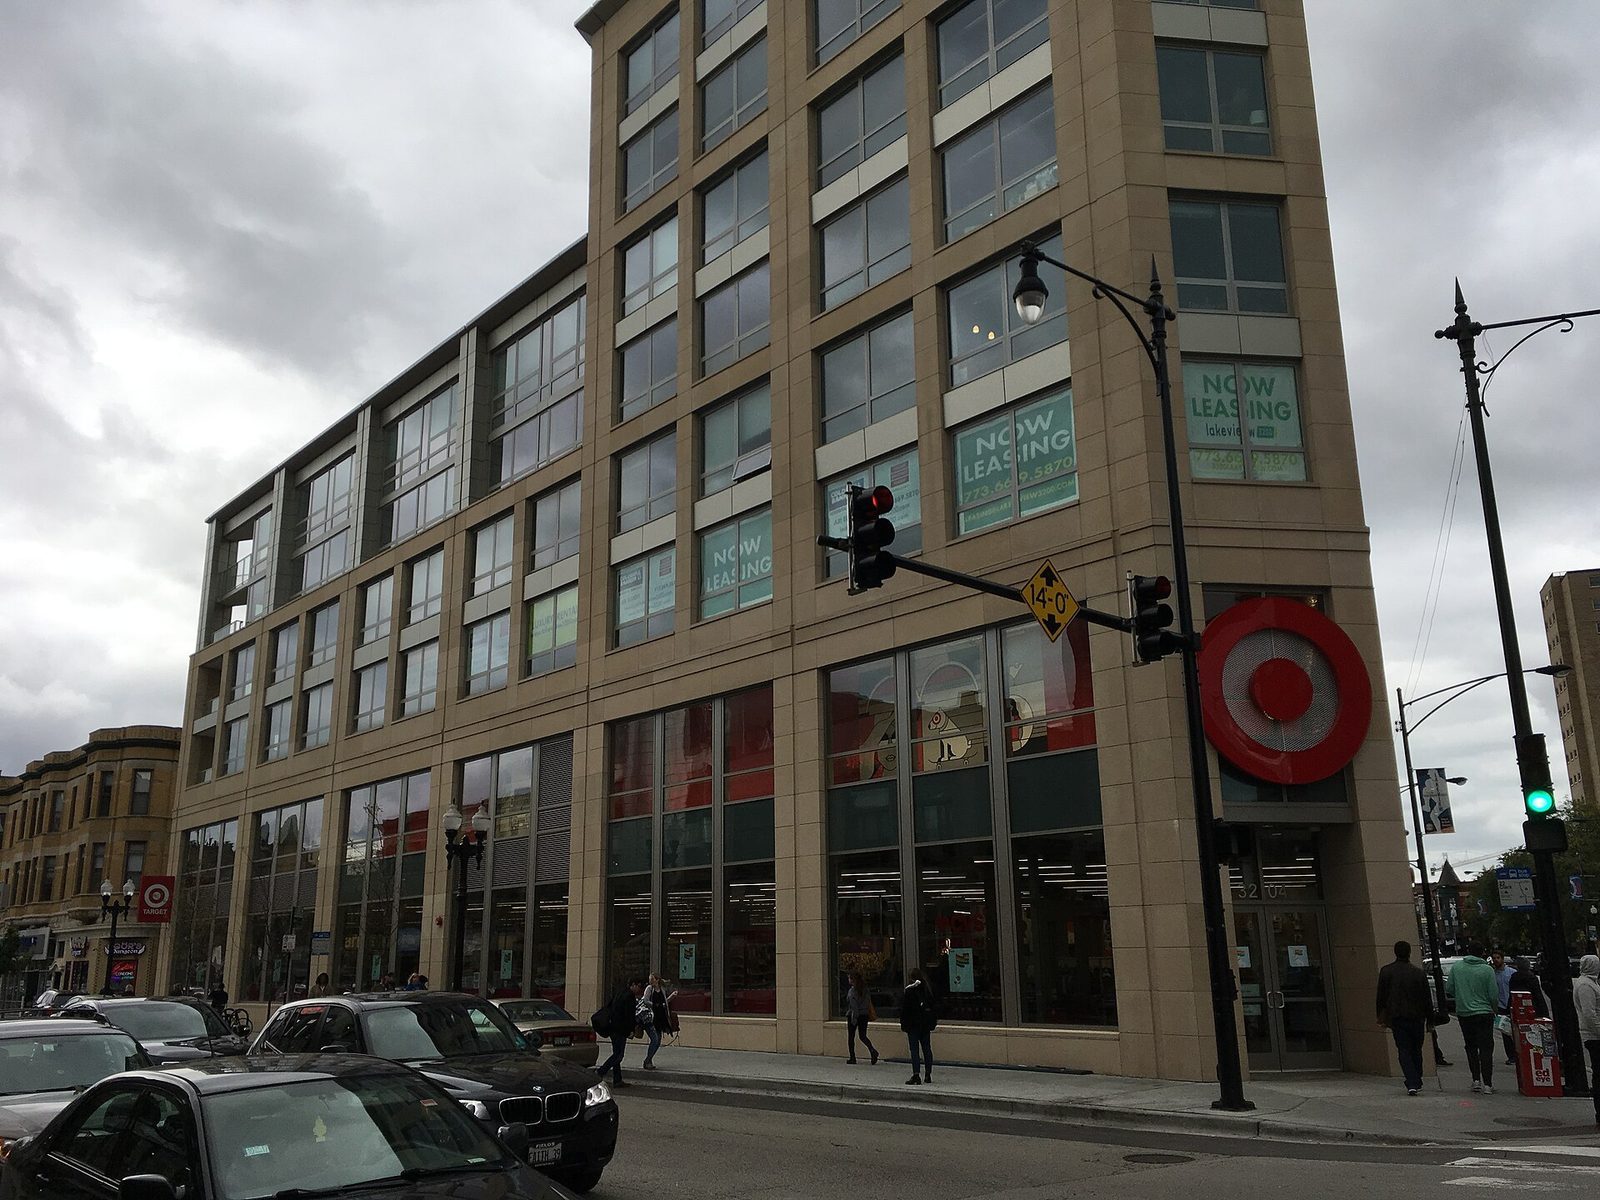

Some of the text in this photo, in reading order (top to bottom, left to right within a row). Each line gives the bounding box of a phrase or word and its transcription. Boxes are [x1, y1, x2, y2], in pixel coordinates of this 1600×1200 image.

[1203, 374, 1276, 397] NOW
[1191, 397, 1292, 421] LEASING
[976, 409, 1054, 456] NOW
[963, 429, 1071, 484] LEASING
[713, 535, 762, 568] NOW
